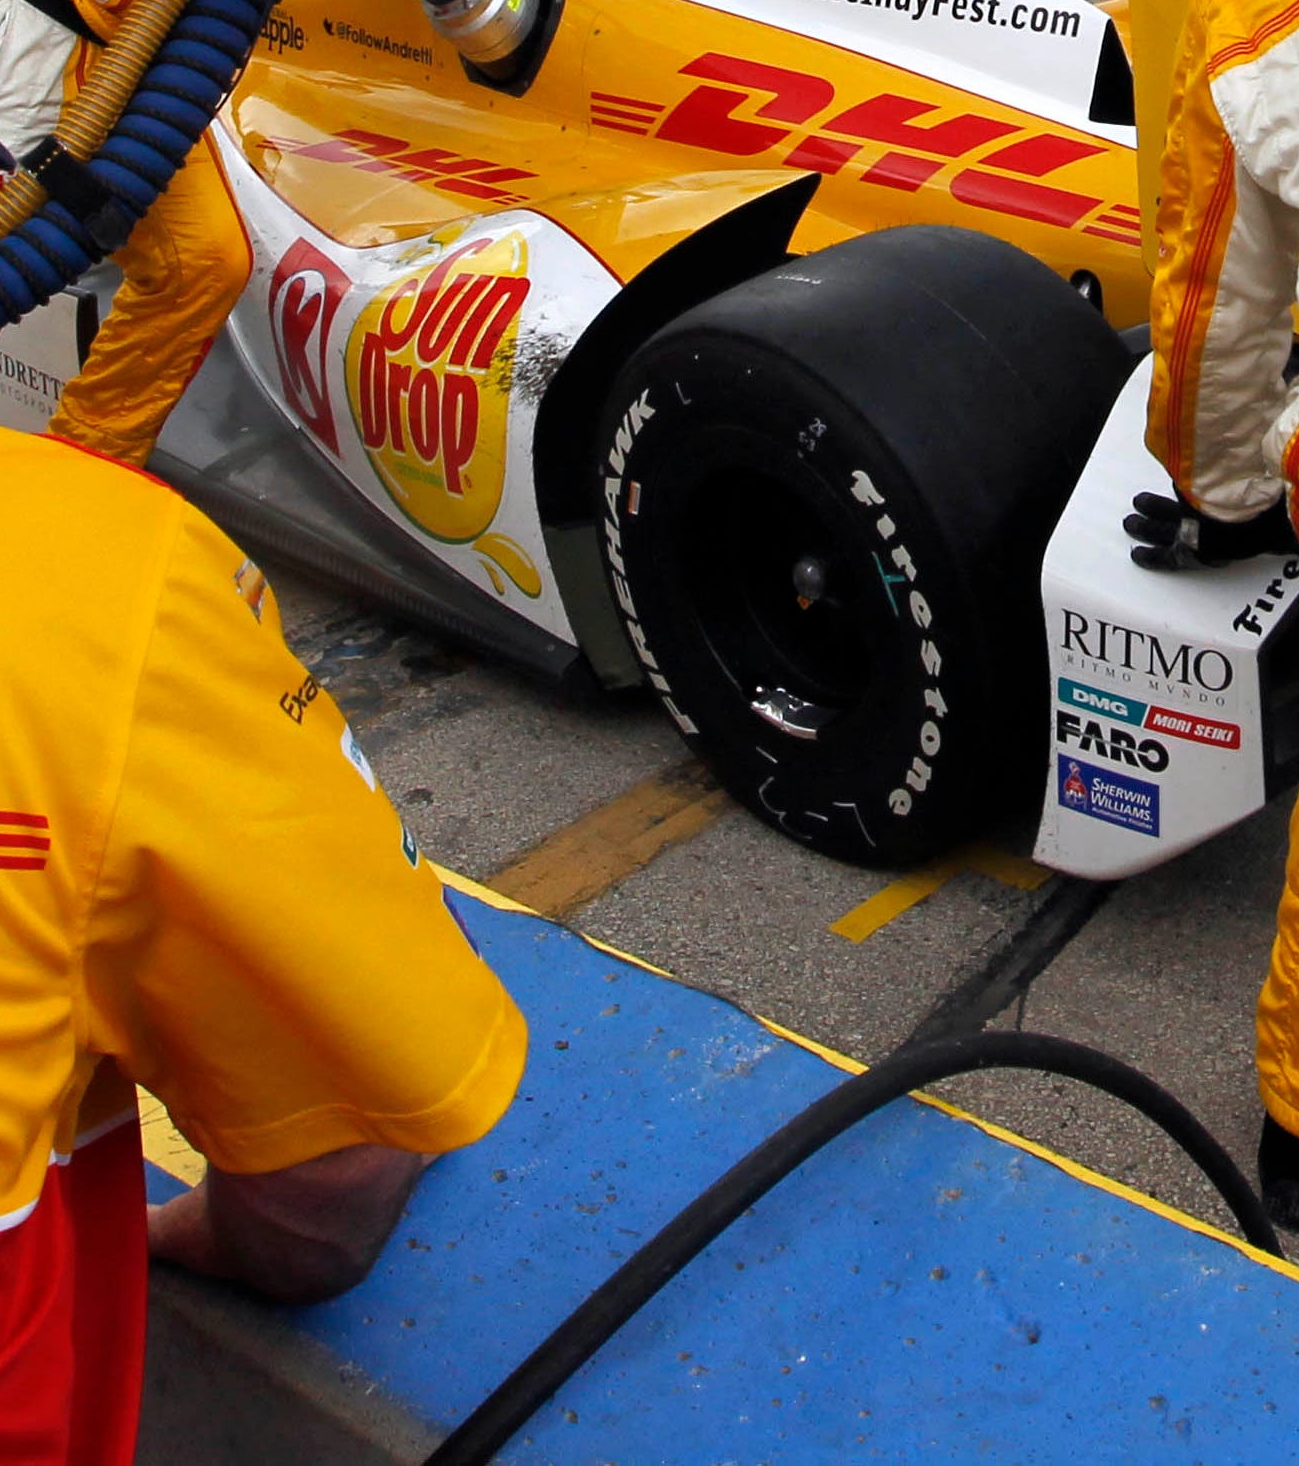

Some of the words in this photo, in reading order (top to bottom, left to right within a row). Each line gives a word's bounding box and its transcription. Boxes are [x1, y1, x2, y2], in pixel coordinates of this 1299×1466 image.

[337, 23, 433, 67] @FollowAndretti
[289, 128, 541, 200] DHL
[654, 51, 1109, 229] DHL
[379, 237, 532, 370] Sun
[358, 331, 479, 495] Drop
[604, 387, 701, 735] FIREHAWK
[849, 468, 950, 818] Firestone
[1060, 608, 1234, 693] RITMO
[1066, 654, 1132, 683] RITMO
[278, 674, 323, 726] Exa
[1071, 687, 1129, 717] DMG
[1152, 713, 1192, 734] MORI
[1193, 723, 1235, 743] SEIKI
[1056, 709, 1170, 774] FARO
[1090, 790, 1152, 822] WILLIAMS
[1091, 777, 1151, 808] SHERWIN
